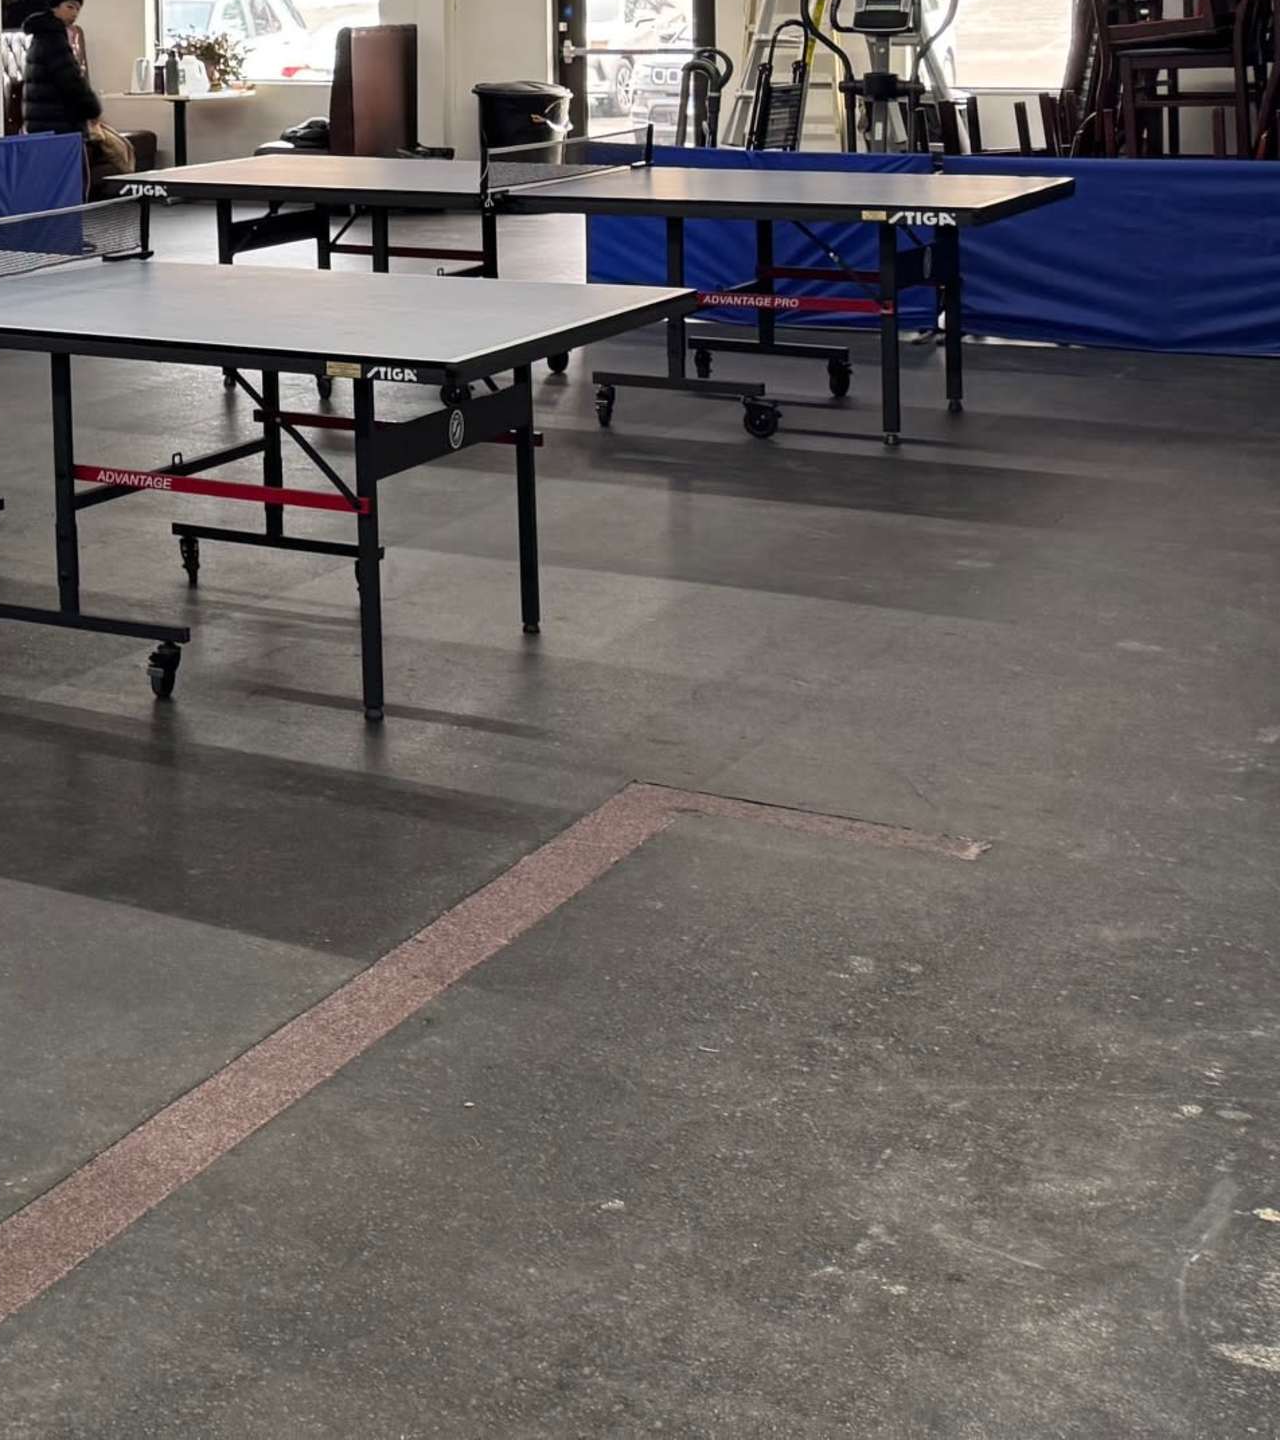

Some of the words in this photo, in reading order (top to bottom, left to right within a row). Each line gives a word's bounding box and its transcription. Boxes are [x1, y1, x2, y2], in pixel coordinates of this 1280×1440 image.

[888, 211, 957, 227] STIGA
[703, 295, 772, 307] ADVANTAGE
[774, 298, 800, 308] PRO
[366, 366, 418, 382] STIGA
[97, 470, 173, 490] ADVANTAGE
